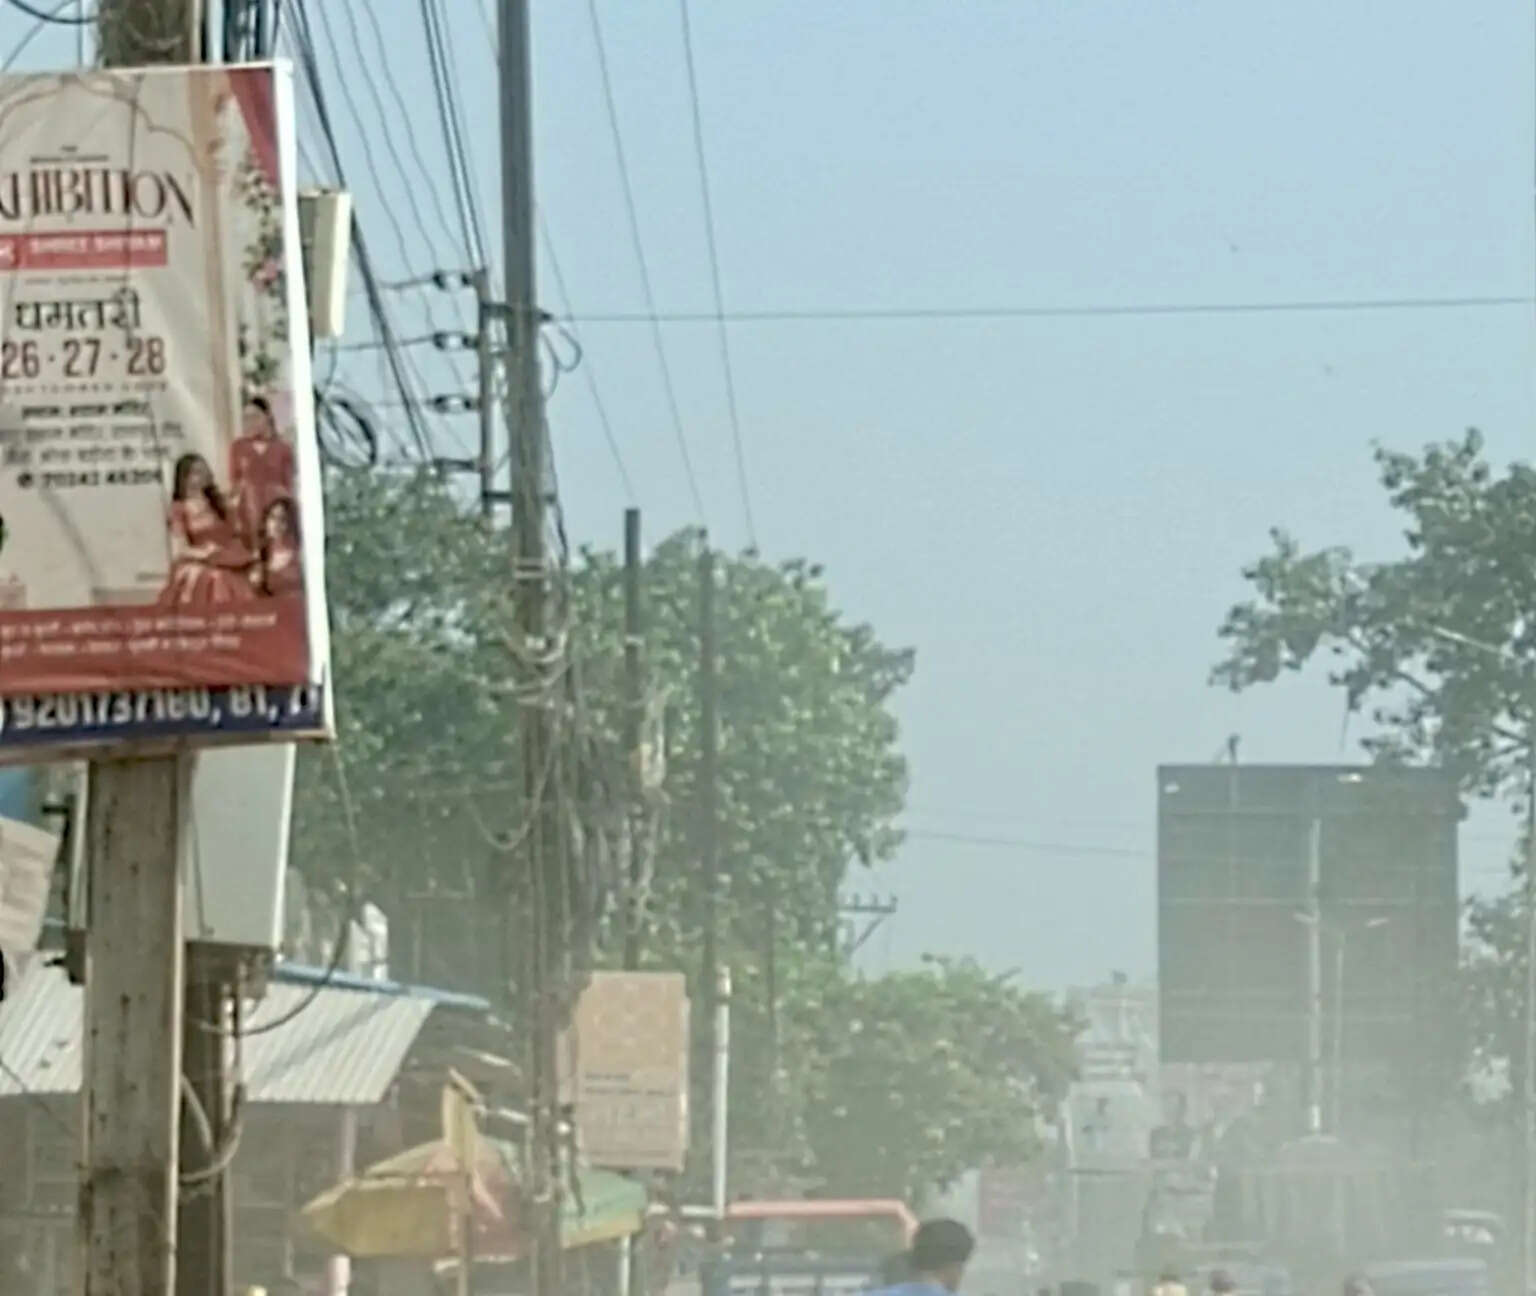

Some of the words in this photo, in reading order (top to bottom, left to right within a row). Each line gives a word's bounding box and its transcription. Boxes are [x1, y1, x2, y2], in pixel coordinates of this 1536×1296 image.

[0, 169, 195, 229] HIBITION
[1, 339, 40, 379] 26
[63, 338, 101, 377] 27
[126, 336, 166, 375] 28
